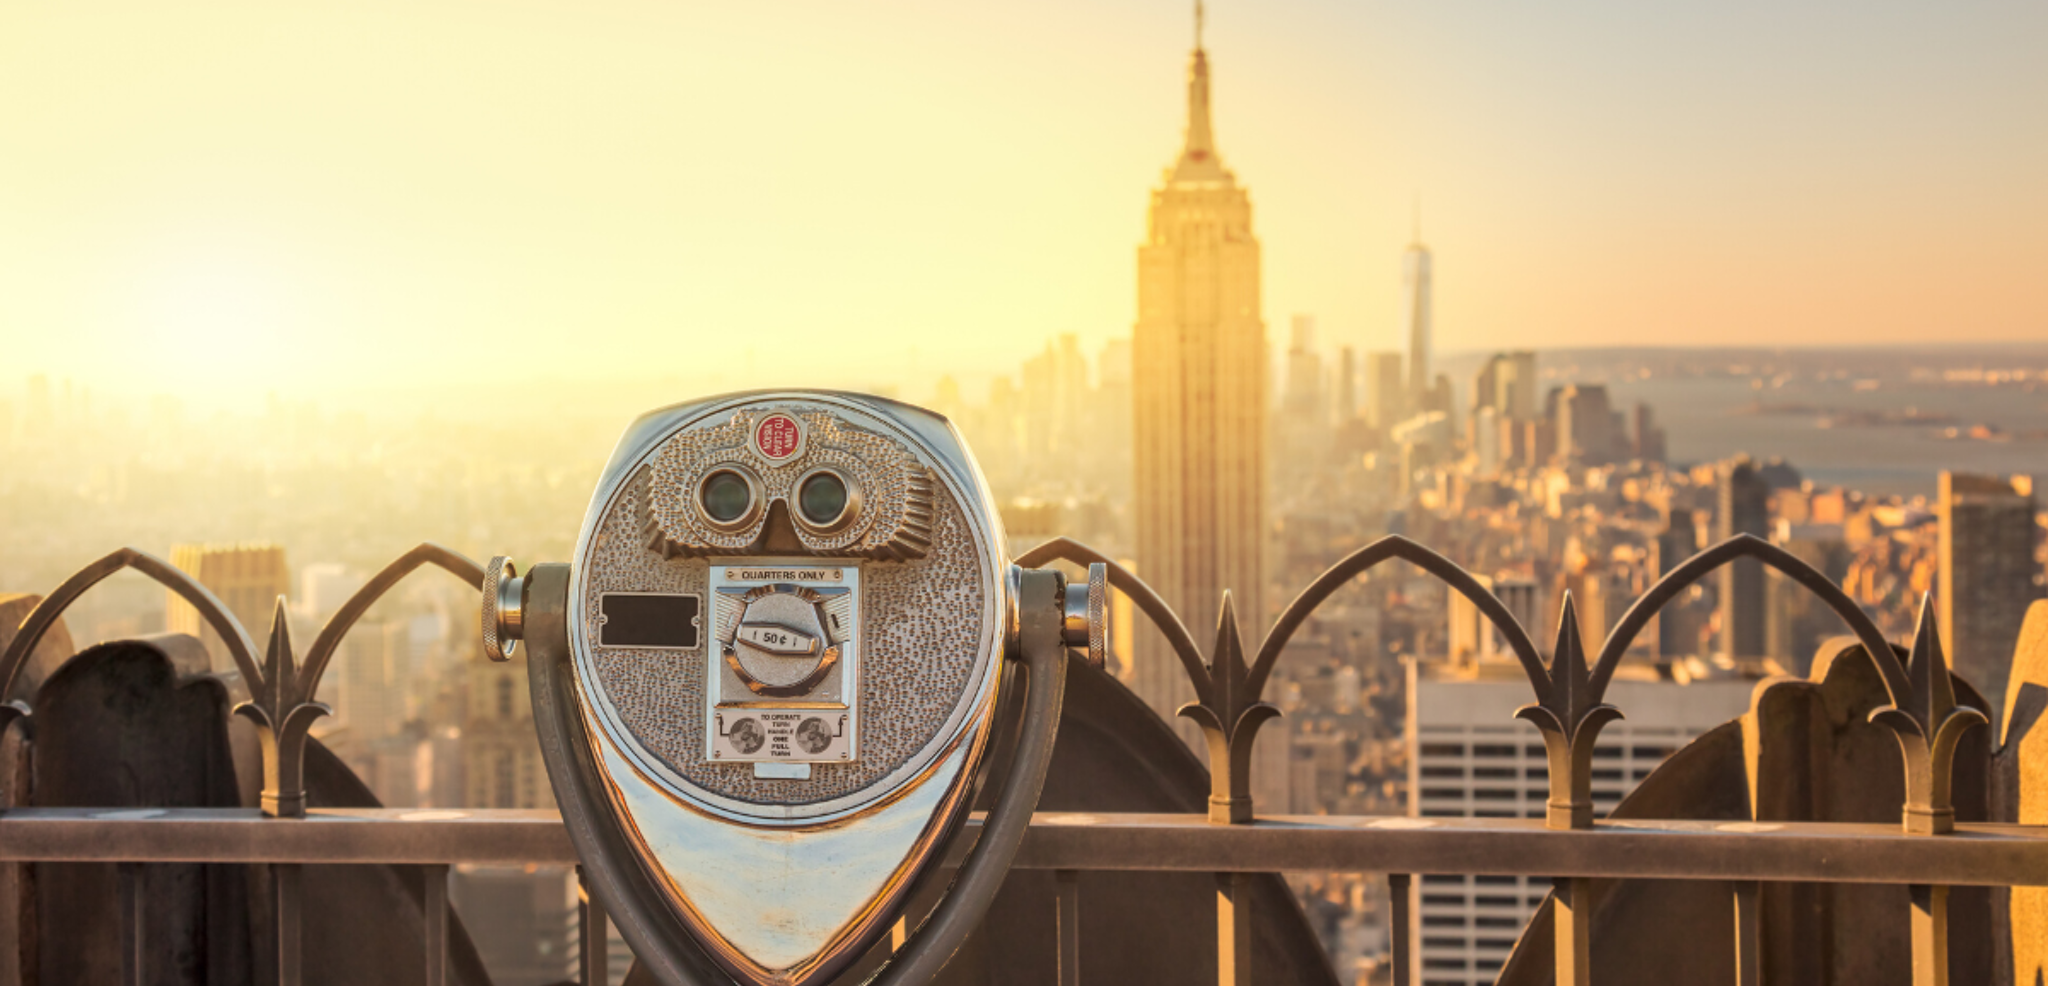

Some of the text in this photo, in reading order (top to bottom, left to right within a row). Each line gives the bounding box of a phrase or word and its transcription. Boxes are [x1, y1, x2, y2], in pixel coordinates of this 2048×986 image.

[763, 424, 772, 450] VISION
[773, 418, 784, 456] TO CLEAR
[785, 426, 794, 448] TURN
[742, 571, 825, 580] QUARTERS ONLY
